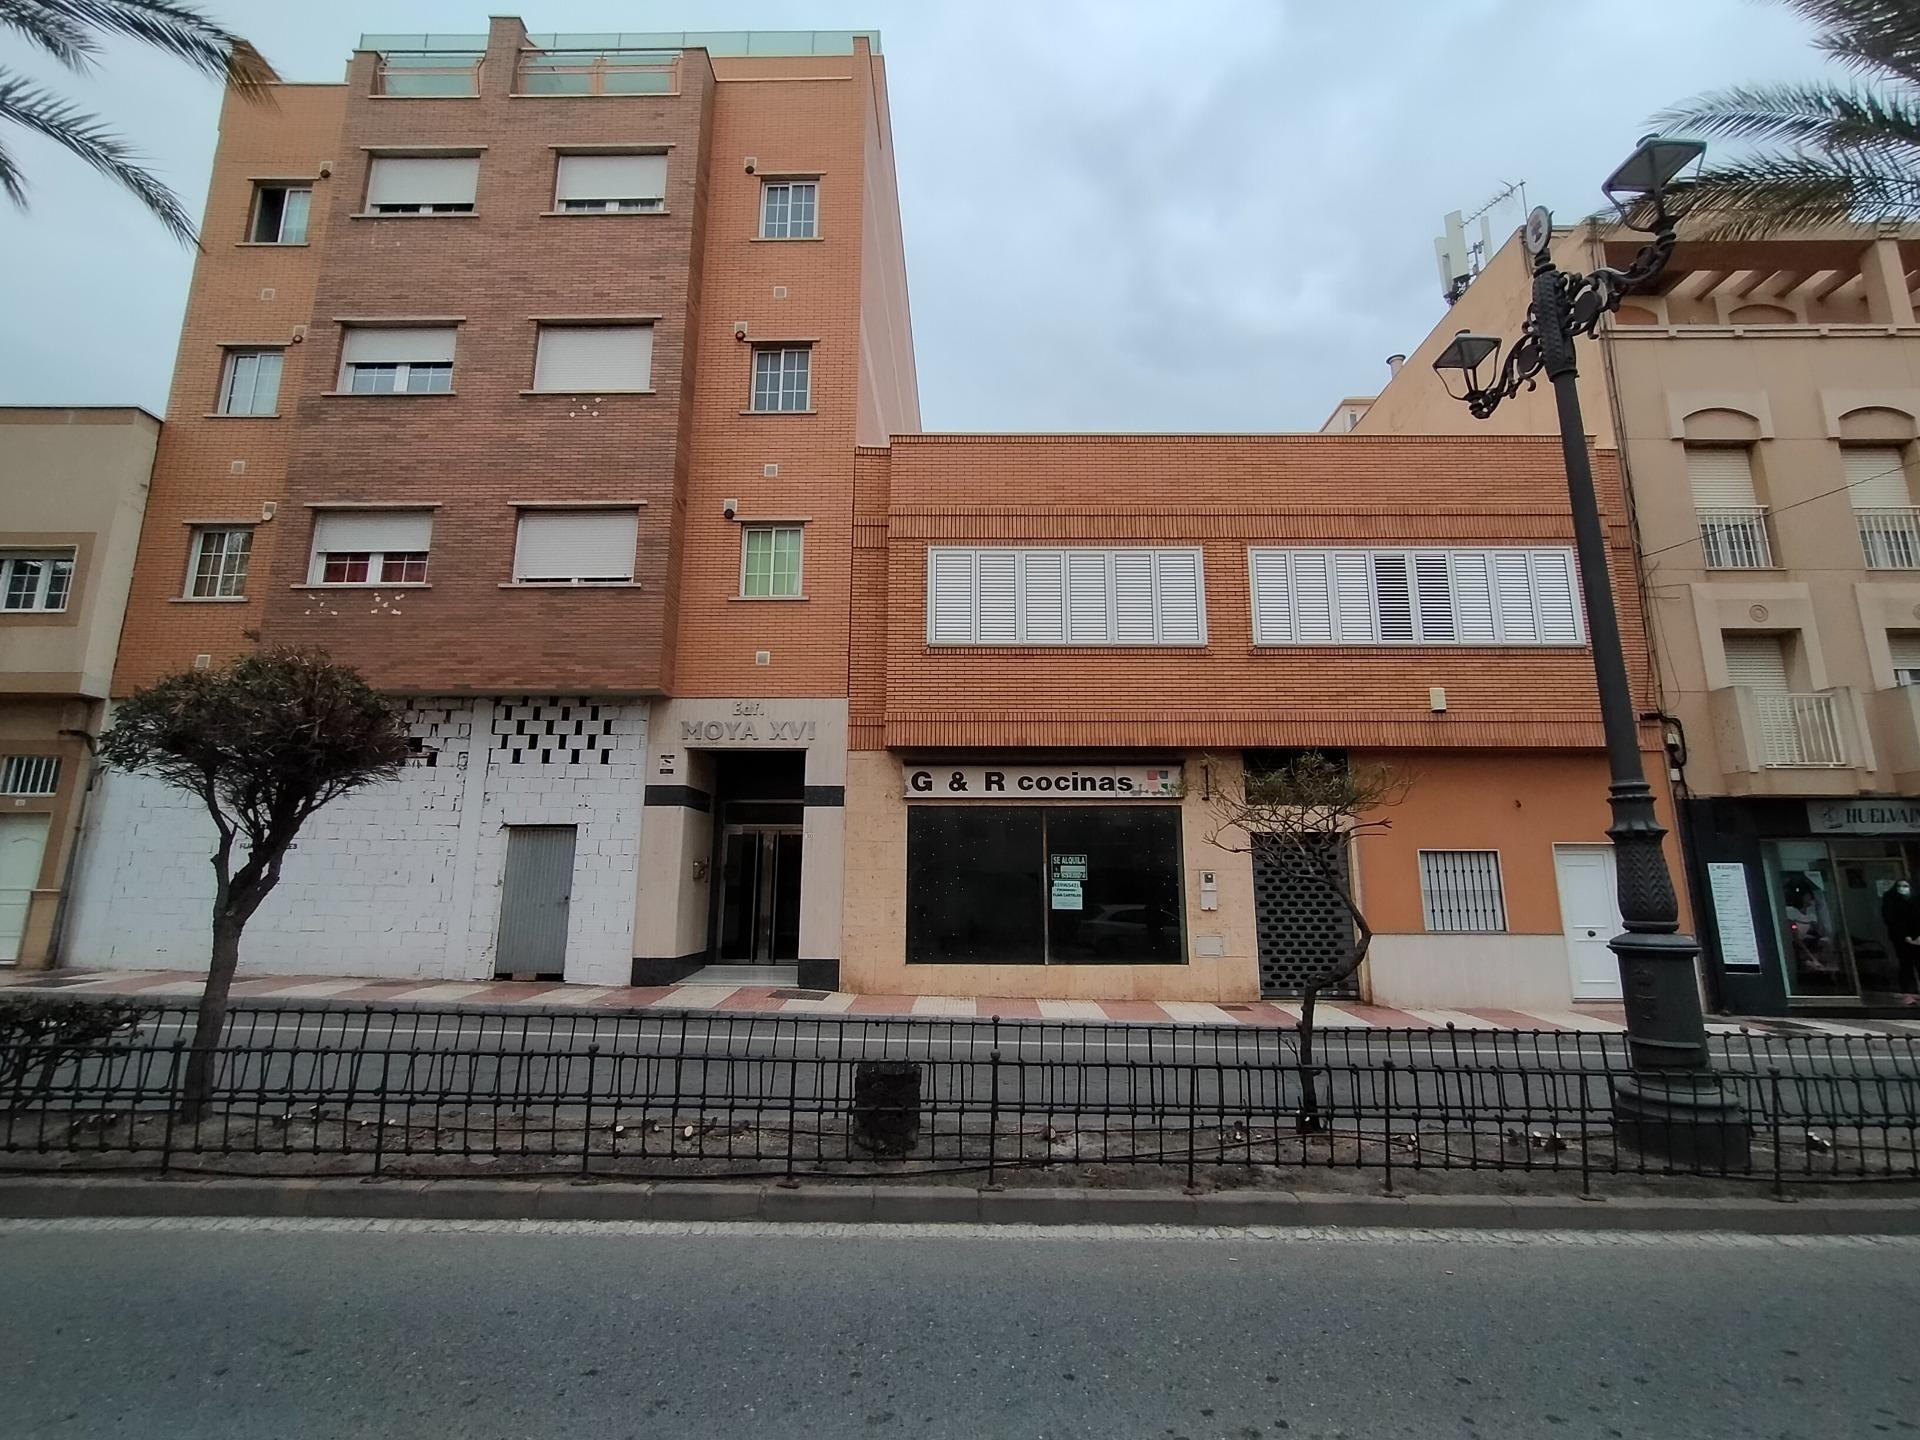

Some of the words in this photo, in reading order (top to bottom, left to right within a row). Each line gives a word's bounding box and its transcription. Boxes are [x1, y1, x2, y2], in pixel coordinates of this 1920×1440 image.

[681, 721, 759, 741] MOYA
[769, 721, 816, 741] XVI
[911, 771, 933, 792] G
[948, 771, 968, 792] &
[984, 771, 1005, 792] R
[1017, 771, 1133, 792] cocinas
